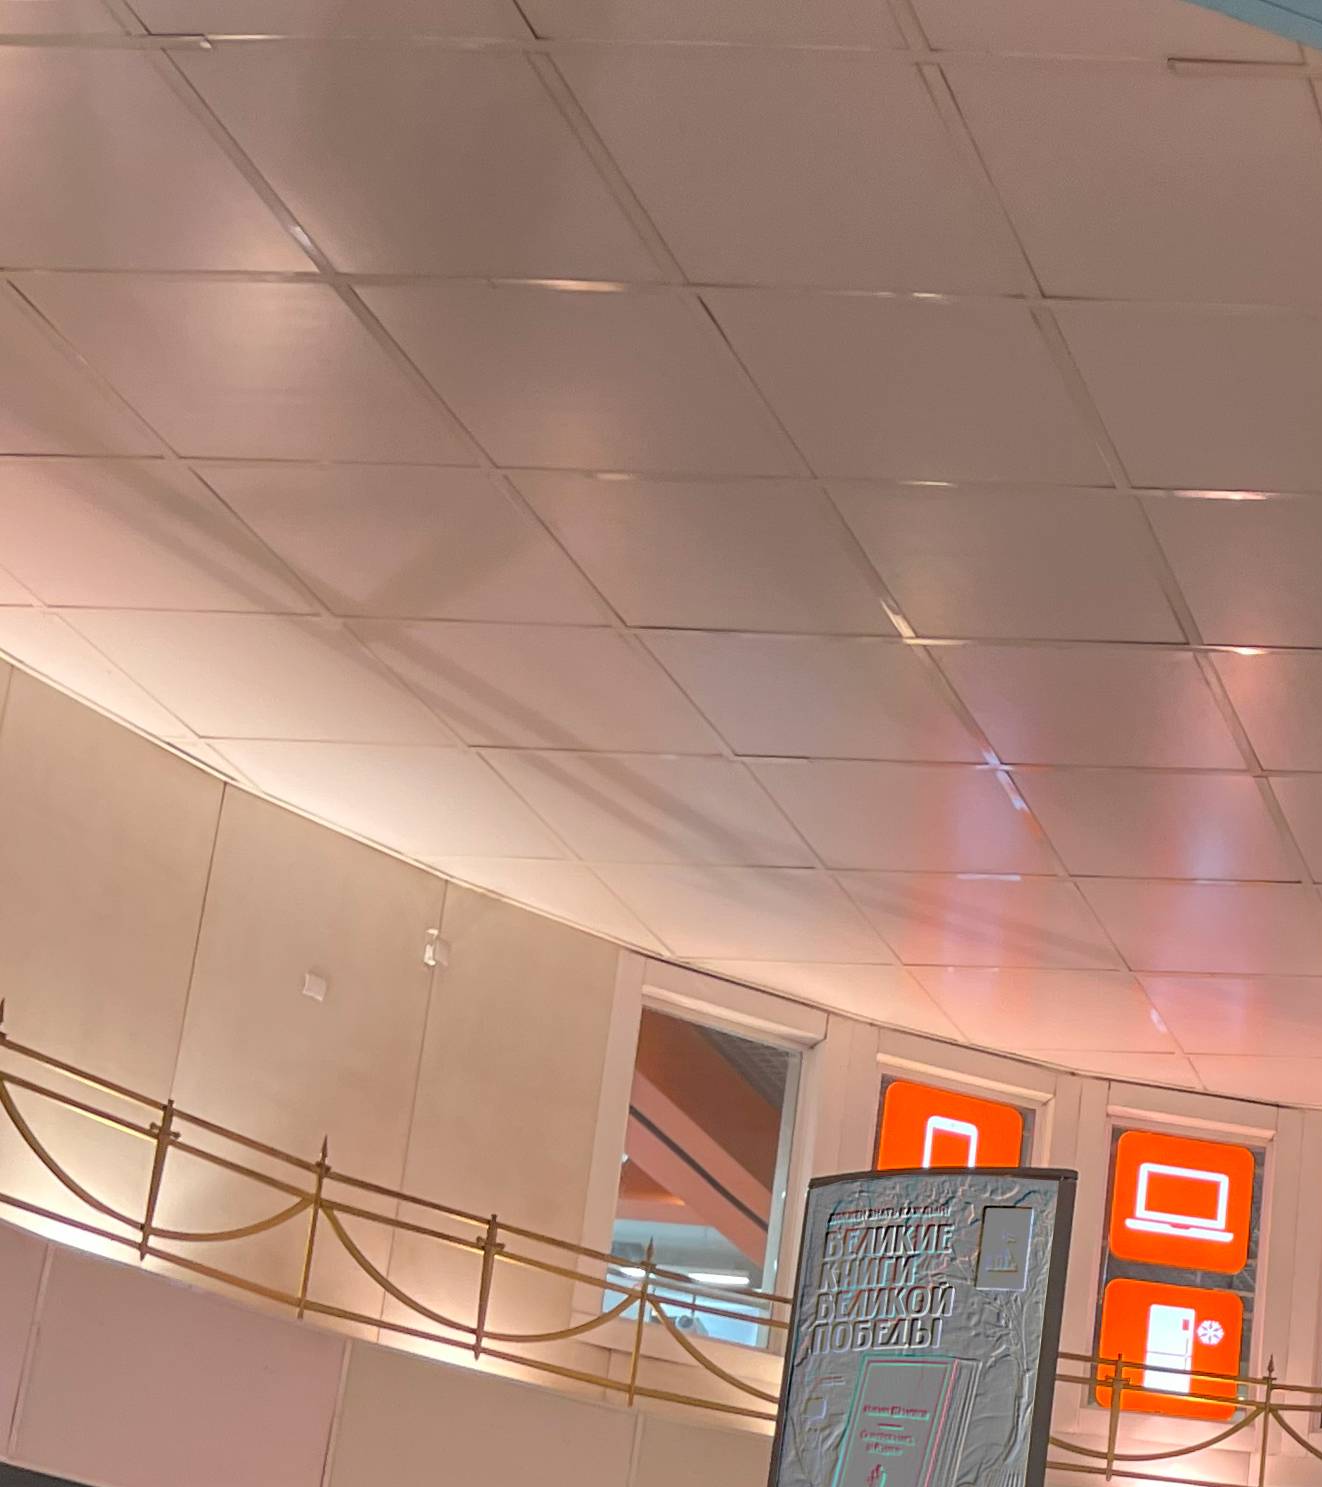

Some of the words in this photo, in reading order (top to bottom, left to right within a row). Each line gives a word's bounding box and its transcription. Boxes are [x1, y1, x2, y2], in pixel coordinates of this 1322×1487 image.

[823, 1223, 955, 1261] ВЕЛИКИЕ
[817, 1254, 917, 1292] КНИГИ
[814, 1281, 956, 1324] ВЕЛИКОЙ
[810, 1318, 943, 1355] ПОБЕДЫ
